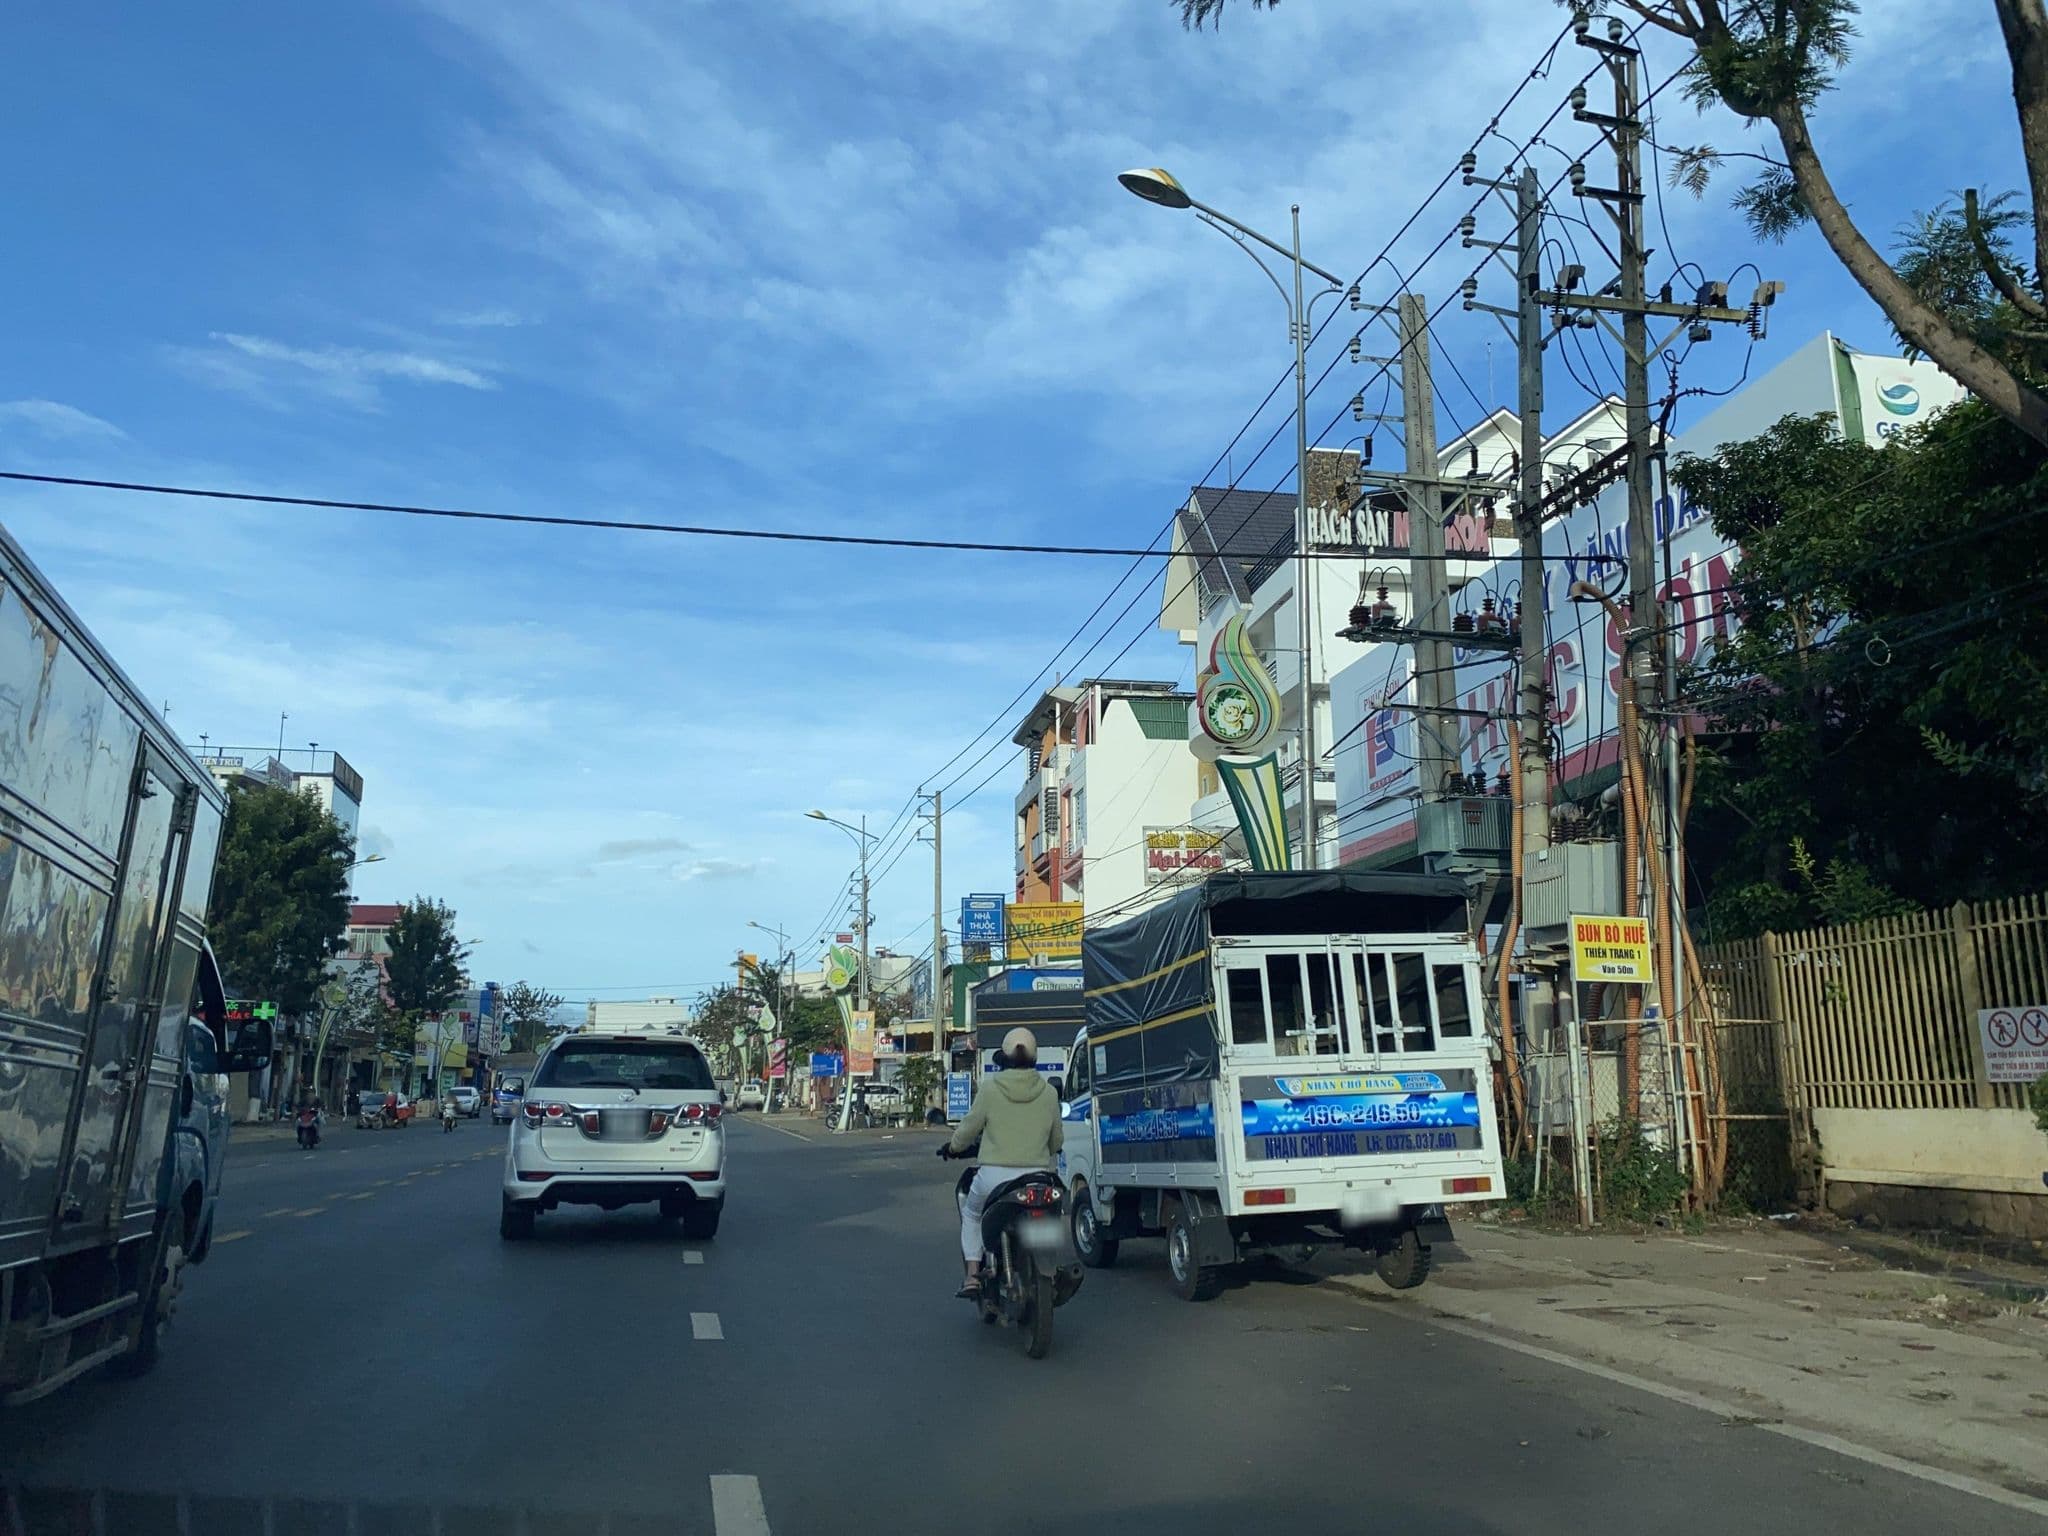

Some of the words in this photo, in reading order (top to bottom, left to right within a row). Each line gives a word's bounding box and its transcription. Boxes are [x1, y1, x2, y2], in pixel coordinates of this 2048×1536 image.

[1577, 921, 1601, 943] BÚN
[1604, 922, 1620, 944] BÒ
[1623, 920, 1646, 944] HUẾ
[1609, 948, 1635, 960] TRANG
[1636, 950, 1641, 960] 1
[1617, 965, 1634, 975] 50m
